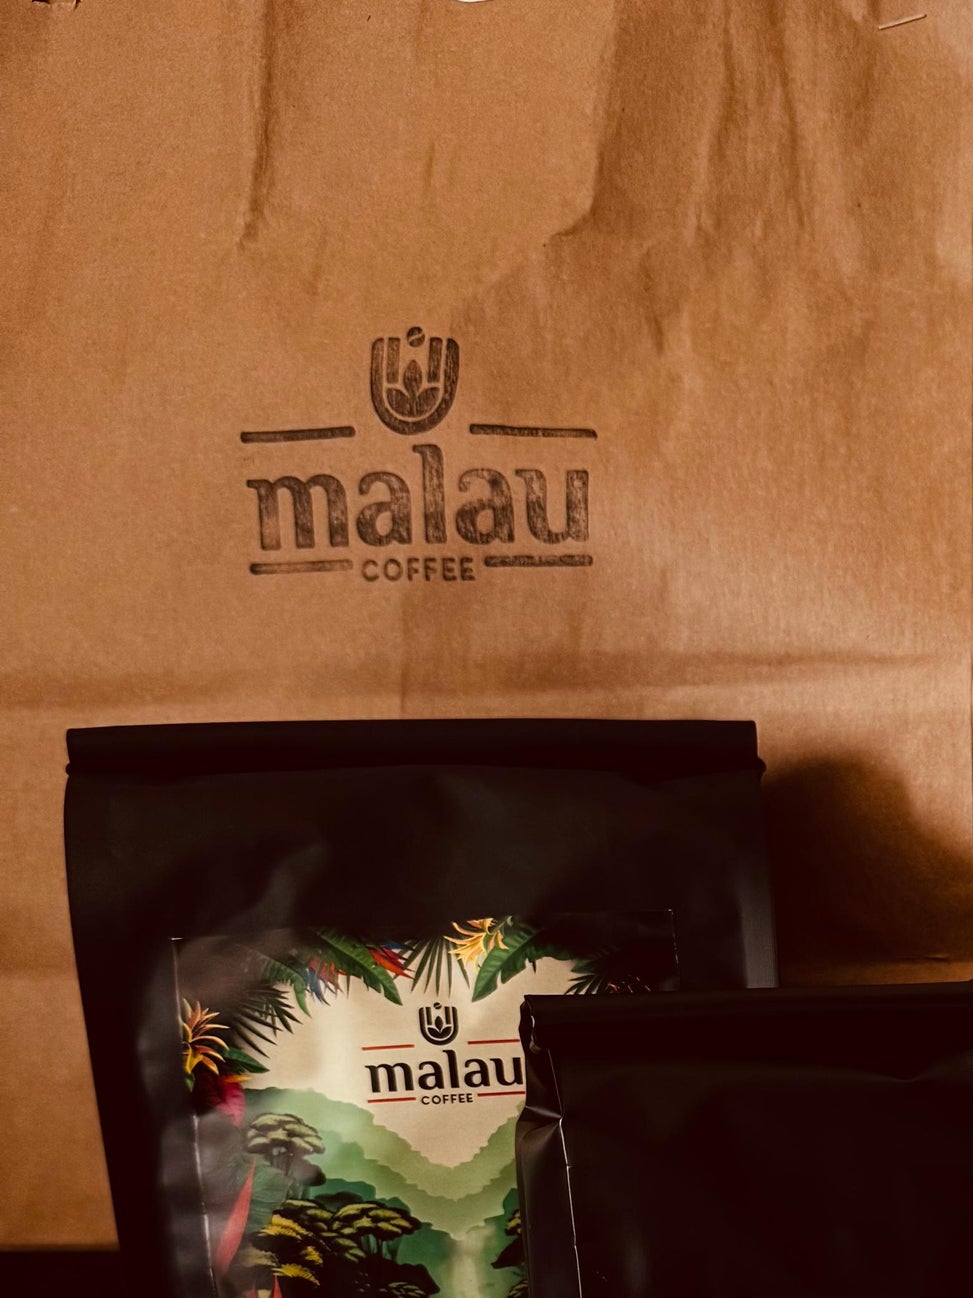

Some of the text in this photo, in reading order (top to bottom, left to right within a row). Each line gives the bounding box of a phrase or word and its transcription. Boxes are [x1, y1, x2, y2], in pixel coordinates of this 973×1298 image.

[246, 444, 590, 551] malau
[361, 556, 476, 582] COFFEE
[364, 1049, 524, 1093] malau
[421, 1093, 474, 1105] COFFEE
